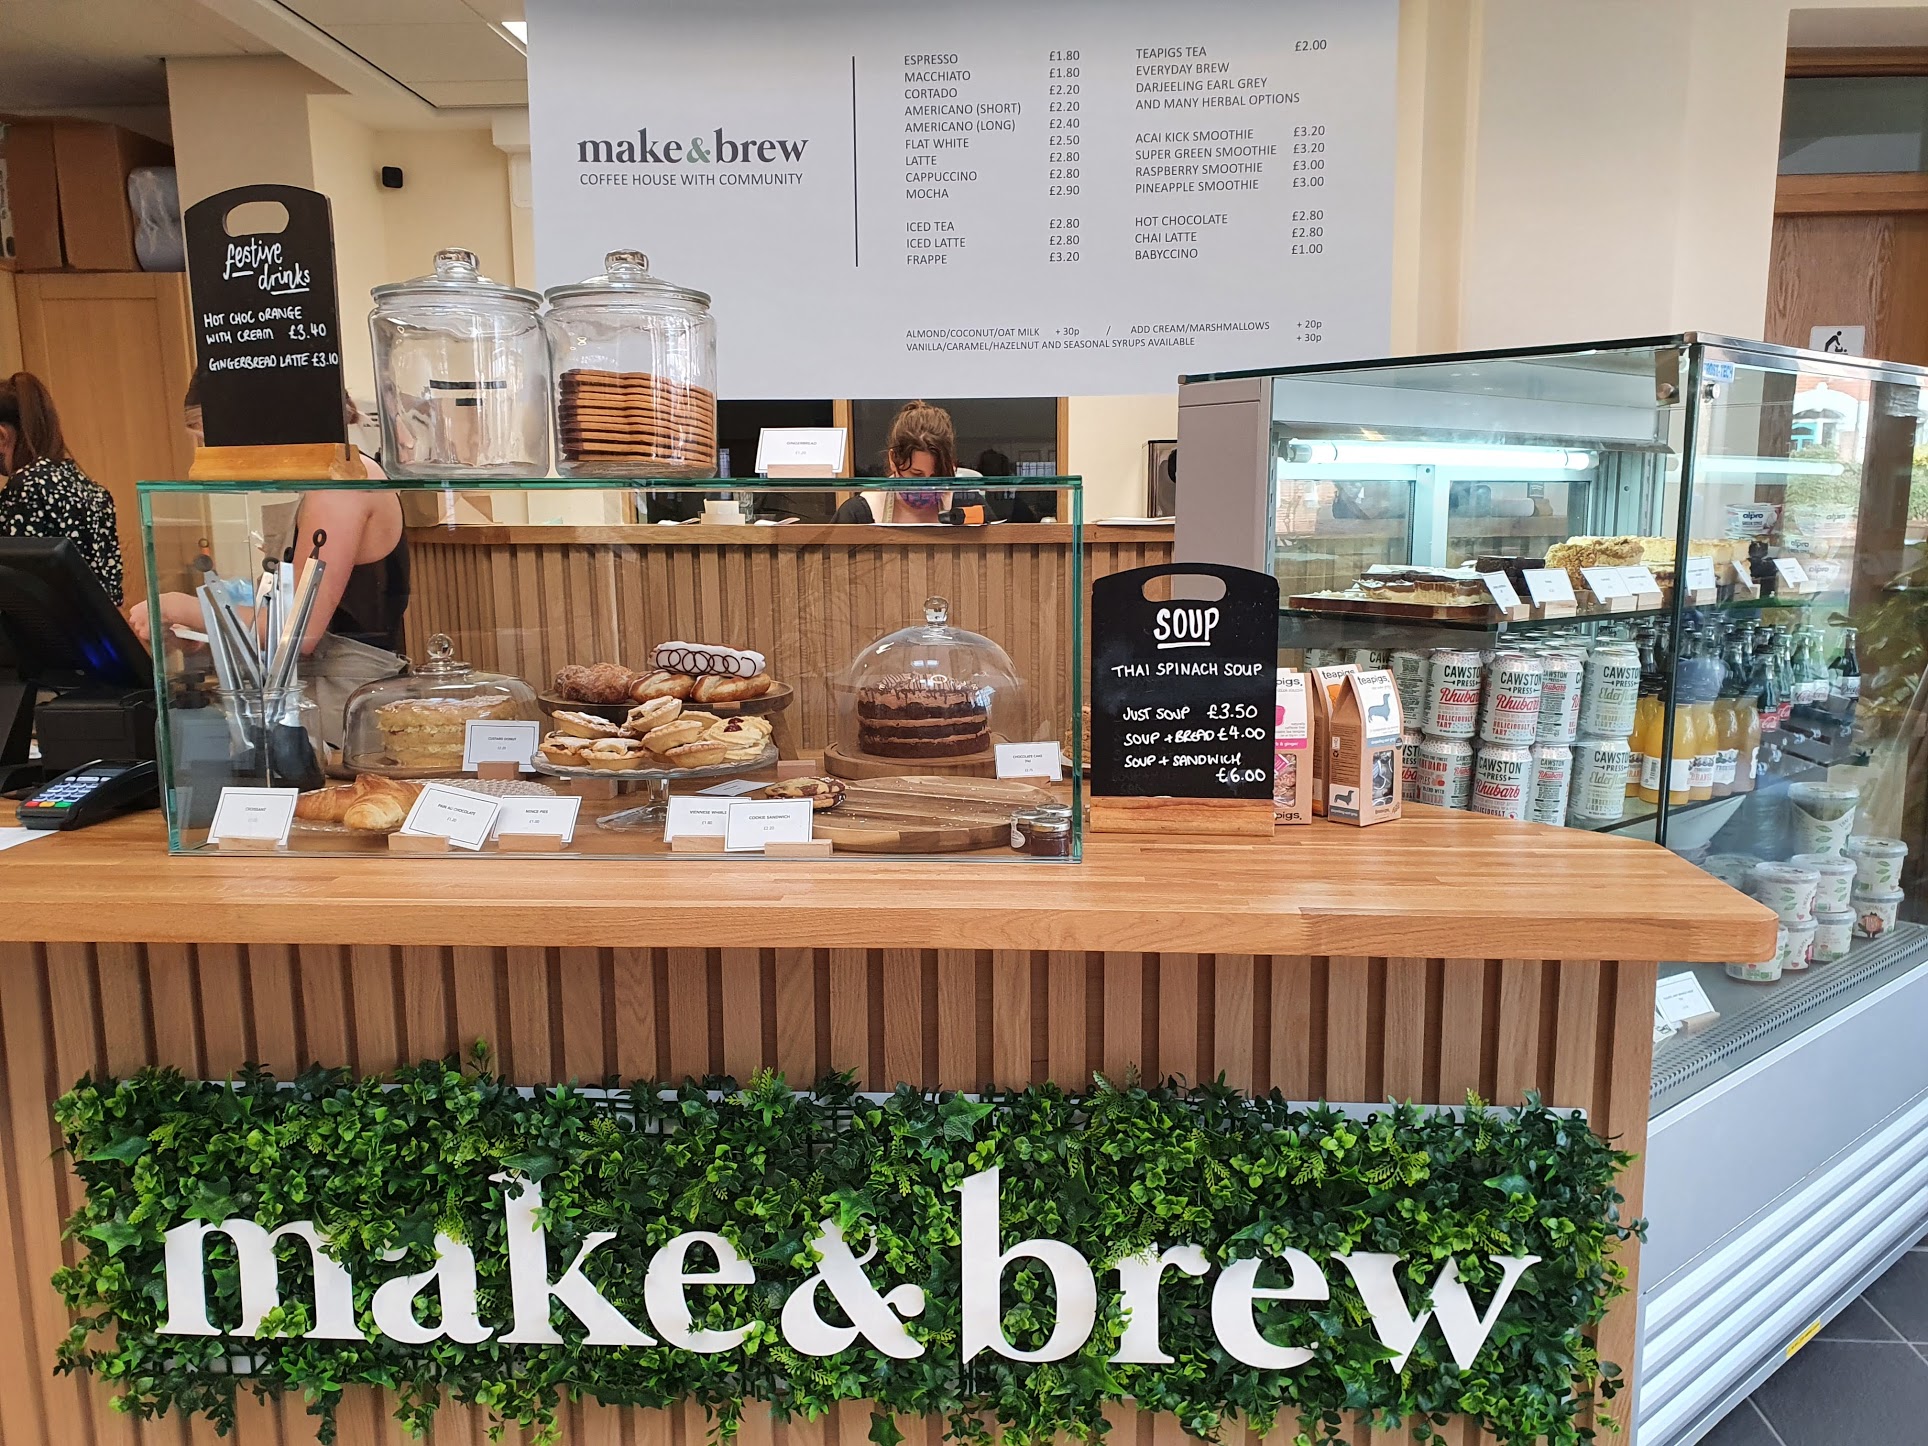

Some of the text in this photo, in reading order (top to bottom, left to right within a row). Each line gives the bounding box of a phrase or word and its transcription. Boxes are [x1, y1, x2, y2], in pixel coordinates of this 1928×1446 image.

[1135, 40, 1327, 59] TEAPIGS TEA £2.00
[904, 51, 1080, 66] ESPRESSO £1.80
[904, 68, 1080, 83] MACCHIATO £1.80
[1136, 62, 1230, 76] EVERYDAY BREW
[904, 85, 1080, 100] CORTADO £2.20
[1136, 78, 1268, 93] DARJEELING EARL GREY
[904, 102, 1080, 117] AMERICANO (SHORT) £2.20
[1135, 93, 1300, 110] AND MANY HERBAL OPTIONS
[904, 118, 1080, 134] AMERICANO (LONG) £2.40
[905, 135, 1080, 150] FLAT WHITE £2.50
[1135, 126, 1326, 144] ACAI KICK SMOOTHIE £3.20
[905, 152, 1080, 166] LATTE £2.80
[1135, 143, 1325, 161] SUPER GREEN SMOOTHIE £3.20
[905, 169, 1080, 183] CAPPUCCINO £2.80
[1135, 160, 1325, 177] RASPBERRY SMOOTHIE £3.00
[580, 173, 803, 186] COFFEE HOUSE WITH COMMUNITY
[1135, 177, 1325, 194] PINEAPPLE SMOOTHIE £3.00
[906, 186, 1080, 199] MOCHA £2.90
[906, 219, 1080, 232] ICED TEA £2.80
[1135, 210, 1324, 227] HOT CHOCOLATE £2.80
[906, 235, 1080, 249] ICED LATTE £2.80
[1134, 227, 1324, 244] CHAI LATTE £2.80
[223, 237, 283, 280] festive
[907, 252, 1080, 265] FRAPPE £3.20
[1135, 244, 1323, 260] BABYCCINO £1.00
[258, 262, 310, 290] drinks
[203, 306, 303, 328] HOT CHOC ORANGE
[206, 323, 327, 345] WITH CREAM £3.40
[1017, 328, 1040, 337] MILK
[1130, 325, 1150, 334] ADD
[1152, 321, 1270, 334] CREAM/MARSHMALLOWS
[906, 341, 1039, 351] VANILLA/CARAMEL/HAZELNUT
[1042, 340, 1061, 349] AND
[1063, 339, 1110, 349] SEASONAL
[1112, 338, 1146, 348] SYRUPS
[1148, 337, 1195, 347] AVAILABLE
[208, 355, 277, 372] GINGERBREAD
[311, 353, 339, 368] £3.10
[1742, 512, 1764, 520] alpro
[1153, 607, 1220, 641] SOUP
[1111, 662, 1263, 678] THAI SPINACH SOUP
[1512, 686, 1533, 694] PRESS
[1122, 703, 1258, 721] JUST SOUP £3.50
[1123, 732, 1161, 747] SOUP
[1217, 726, 1266, 742] £4.00
[1124, 755, 1157, 768] SOUP
[1172, 753, 1242, 767] SANDWICH
[1478, 757, 1522, 774] CAWSTON
[1215, 768, 1266, 783] £6.00
[1486, 772, 1507, 782] PRESS
[1475, 779, 1520, 799] Rhubarb
